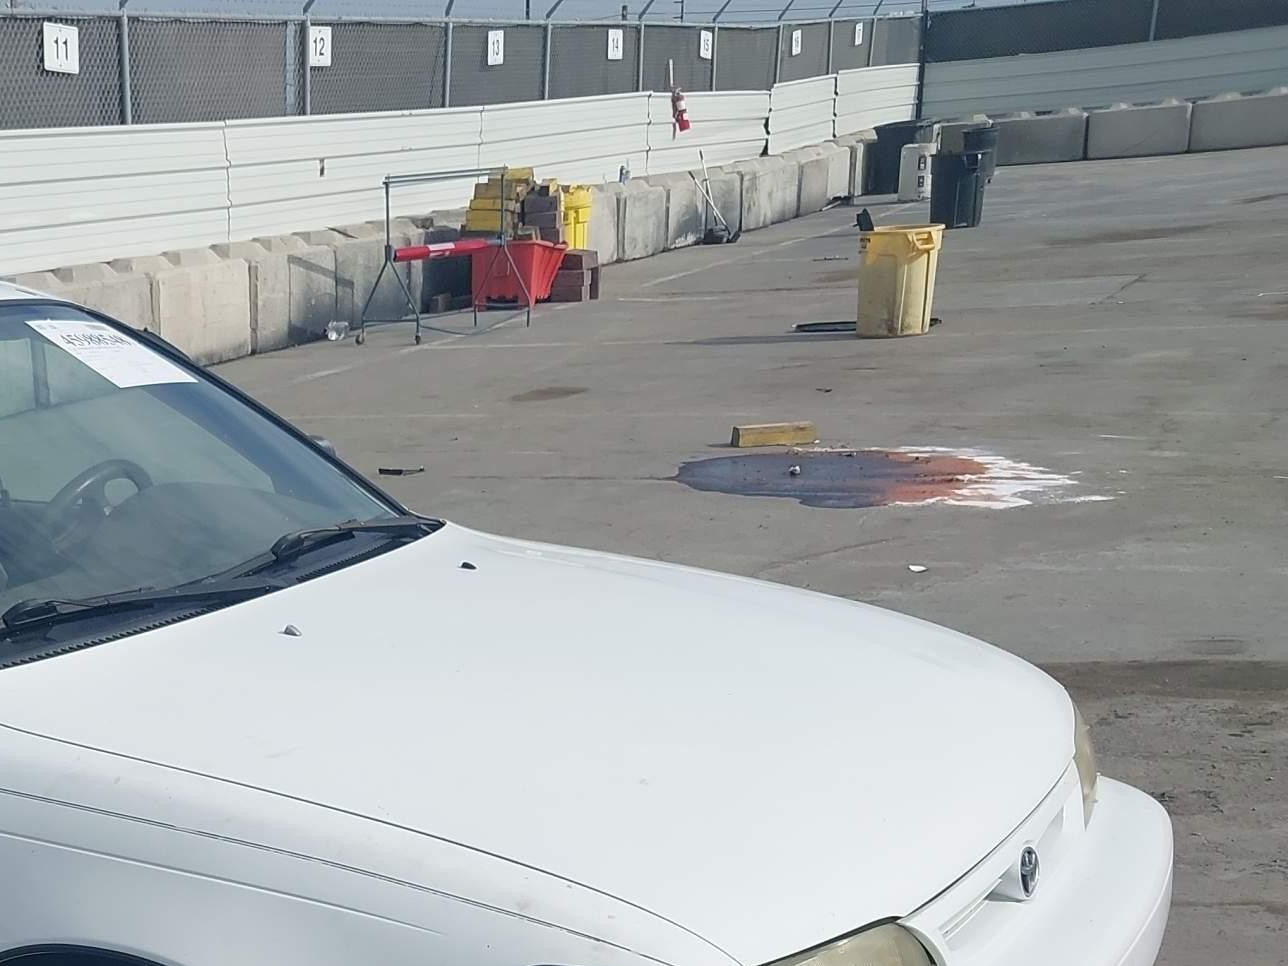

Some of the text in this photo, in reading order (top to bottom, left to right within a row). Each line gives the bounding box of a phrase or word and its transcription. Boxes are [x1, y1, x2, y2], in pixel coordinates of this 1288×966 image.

[54, 37, 68, 61] 11
[313, 37, 325, 56] 12
[492, 39, 500, 56] 13
[612, 37, 619, 50] 14
